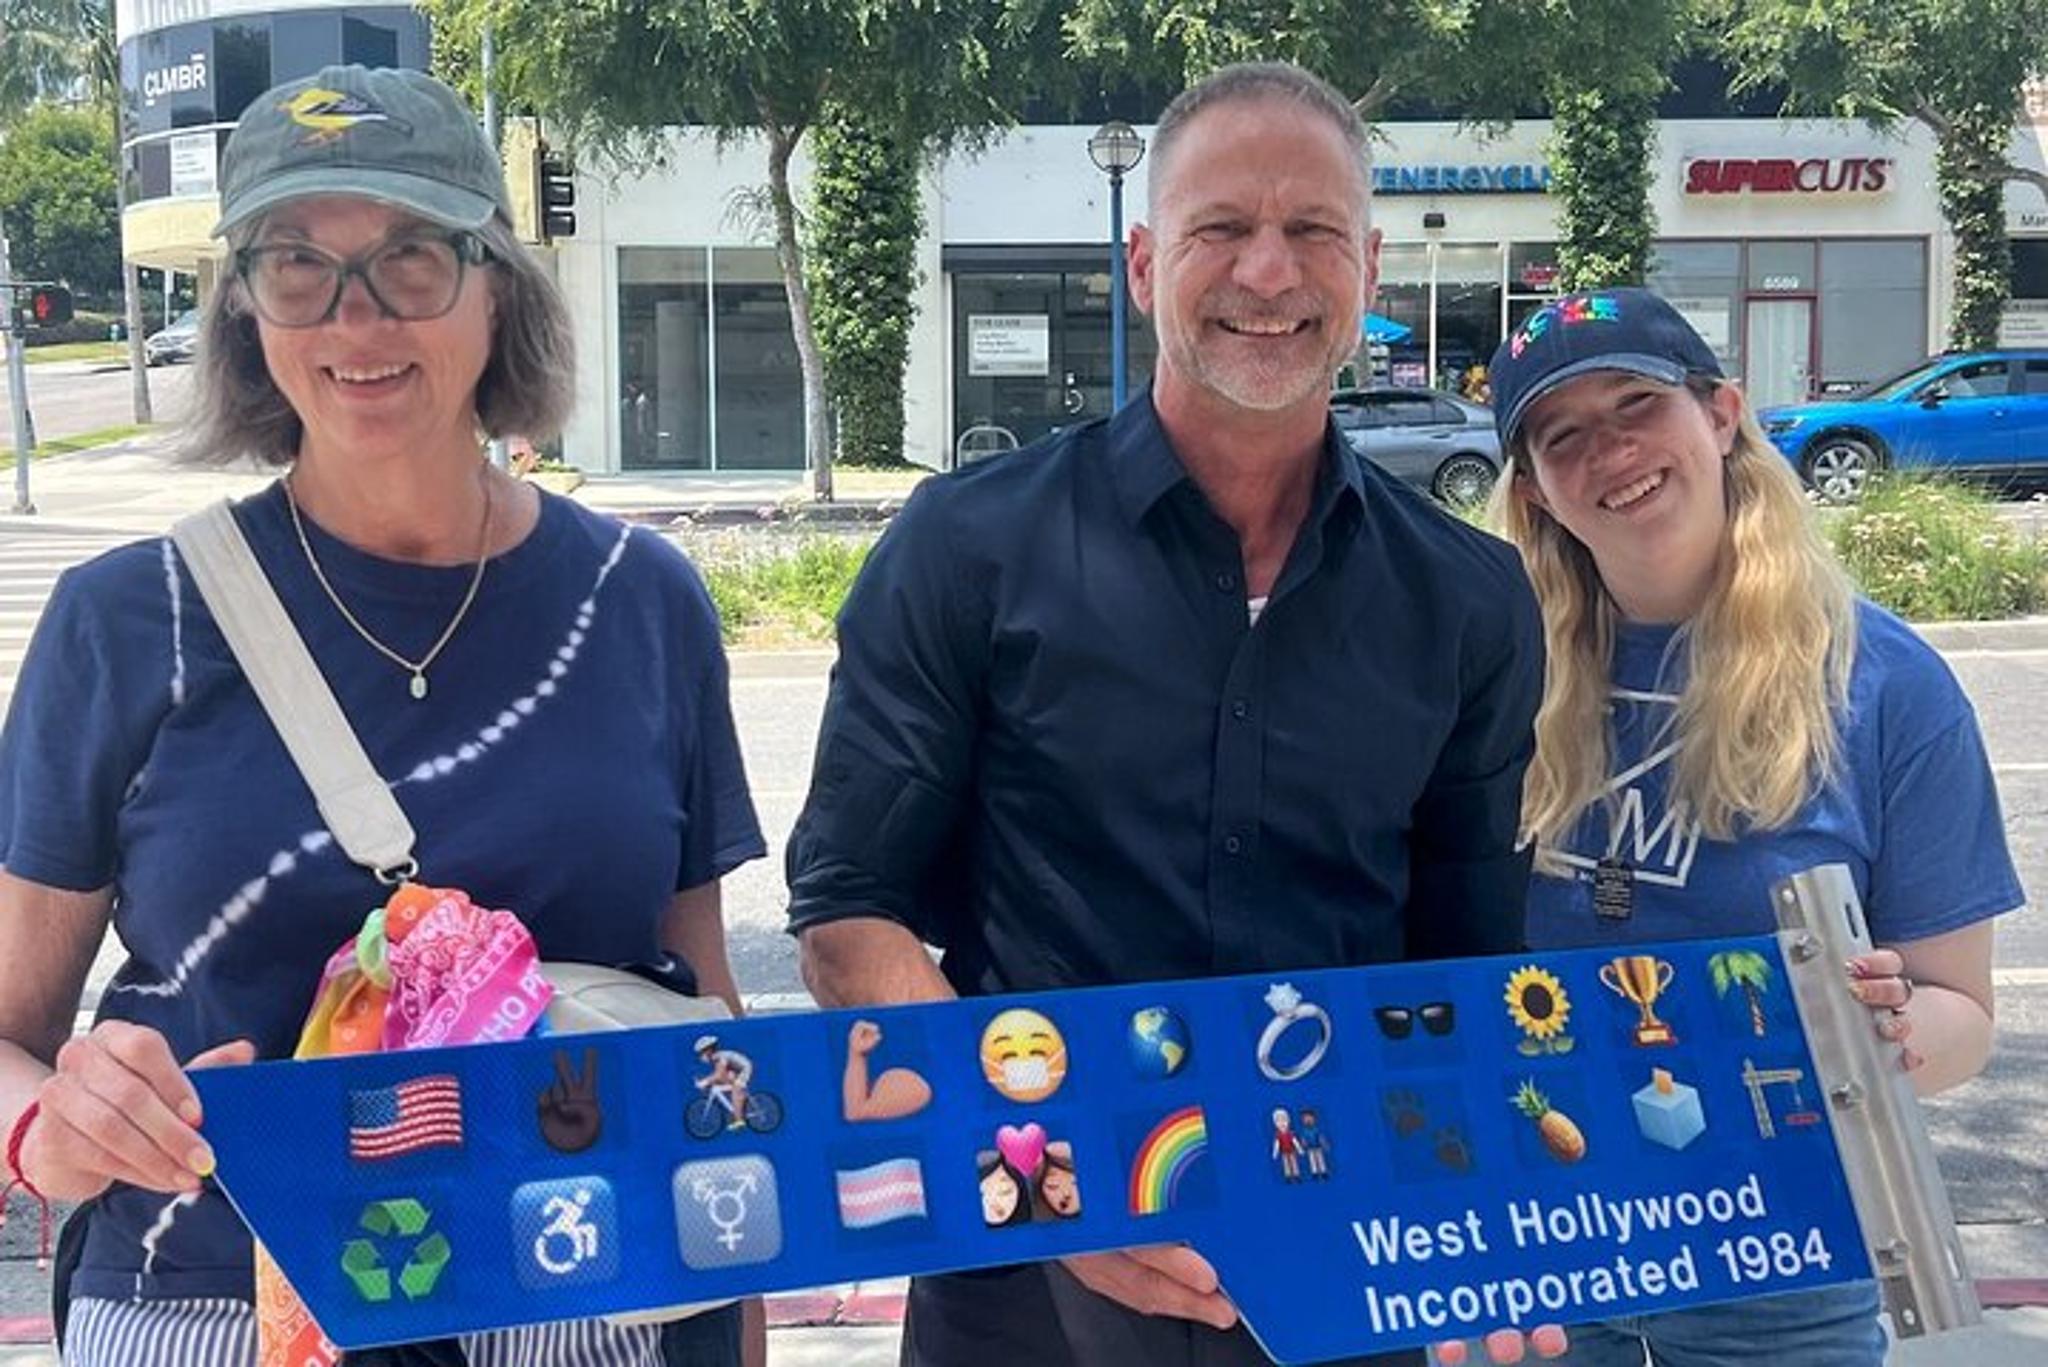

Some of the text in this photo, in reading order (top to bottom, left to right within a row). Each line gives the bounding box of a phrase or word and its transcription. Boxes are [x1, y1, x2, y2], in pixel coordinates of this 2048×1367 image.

[1686, 159, 1887, 194] SUPERCUTS
[1352, 1173, 1766, 1266] West Hollywood
[1364, 1226, 1832, 1334] Incorporated 1984
